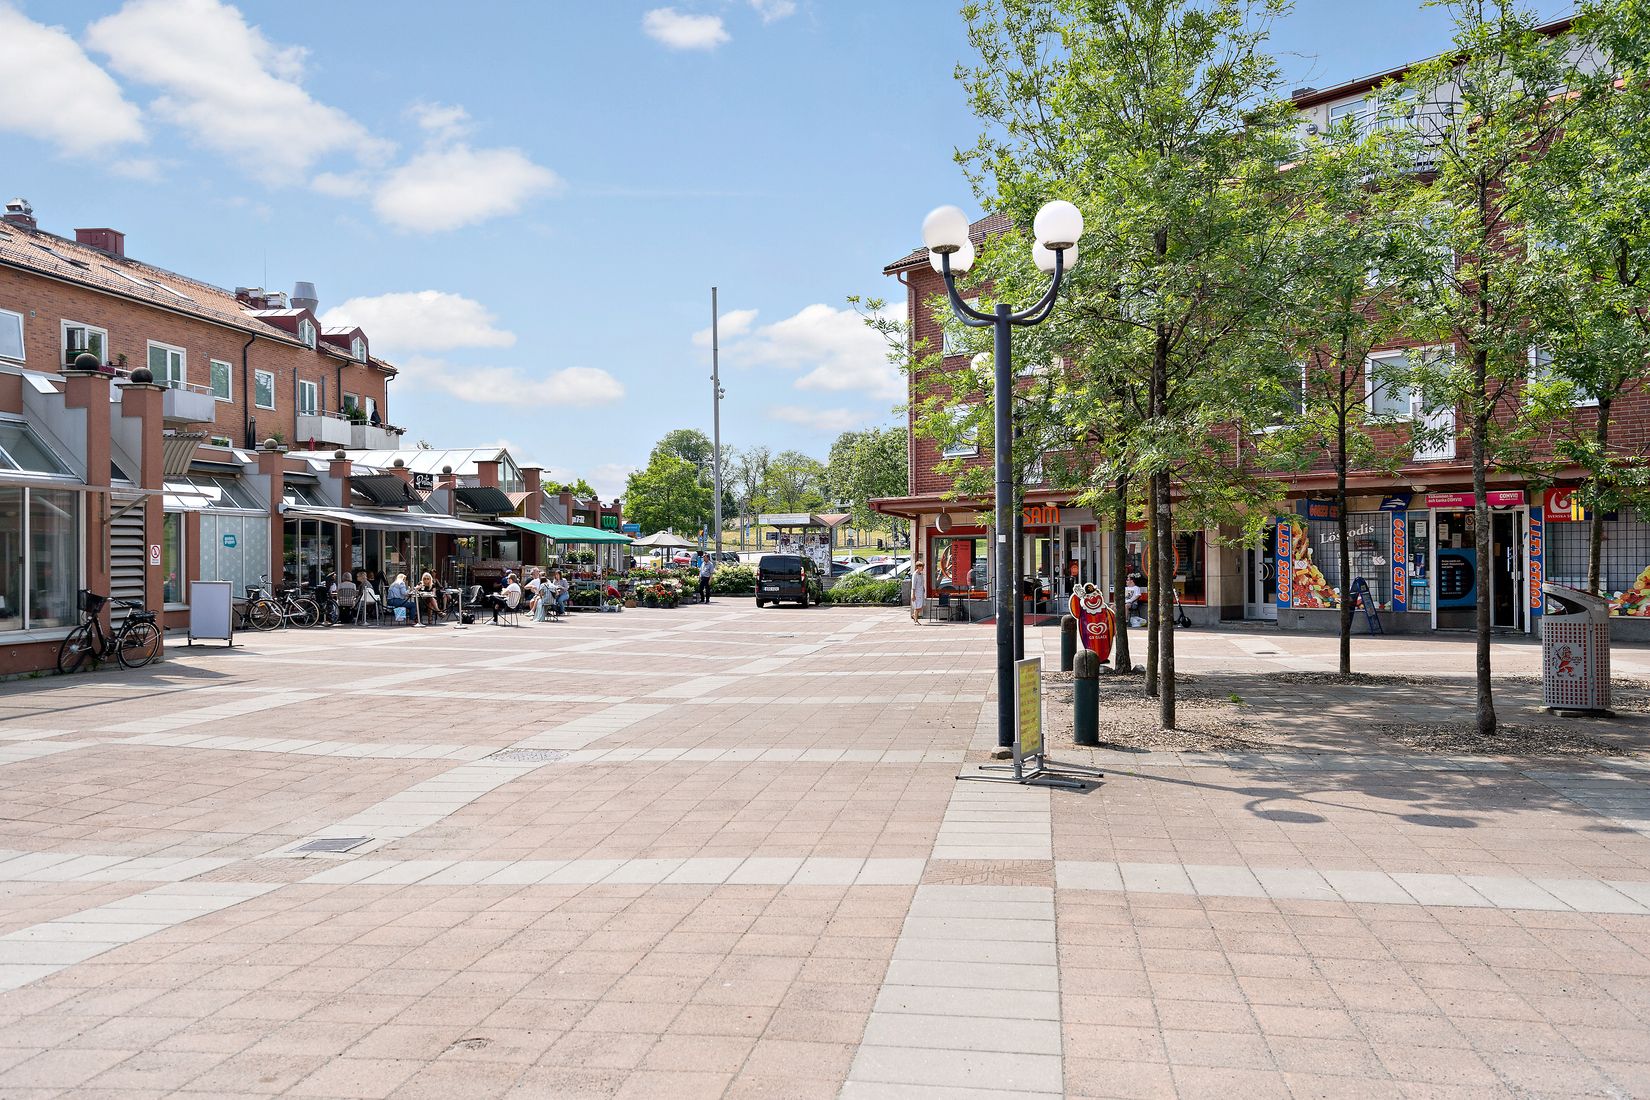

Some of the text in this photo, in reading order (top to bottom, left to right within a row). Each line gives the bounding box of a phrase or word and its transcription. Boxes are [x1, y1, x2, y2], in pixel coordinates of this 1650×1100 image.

[1278, 522, 1289, 602] GODIS CITY
[1393, 518, 1406, 603] GODIS CITY
[1530, 517, 1541, 608] GODIS CITY
